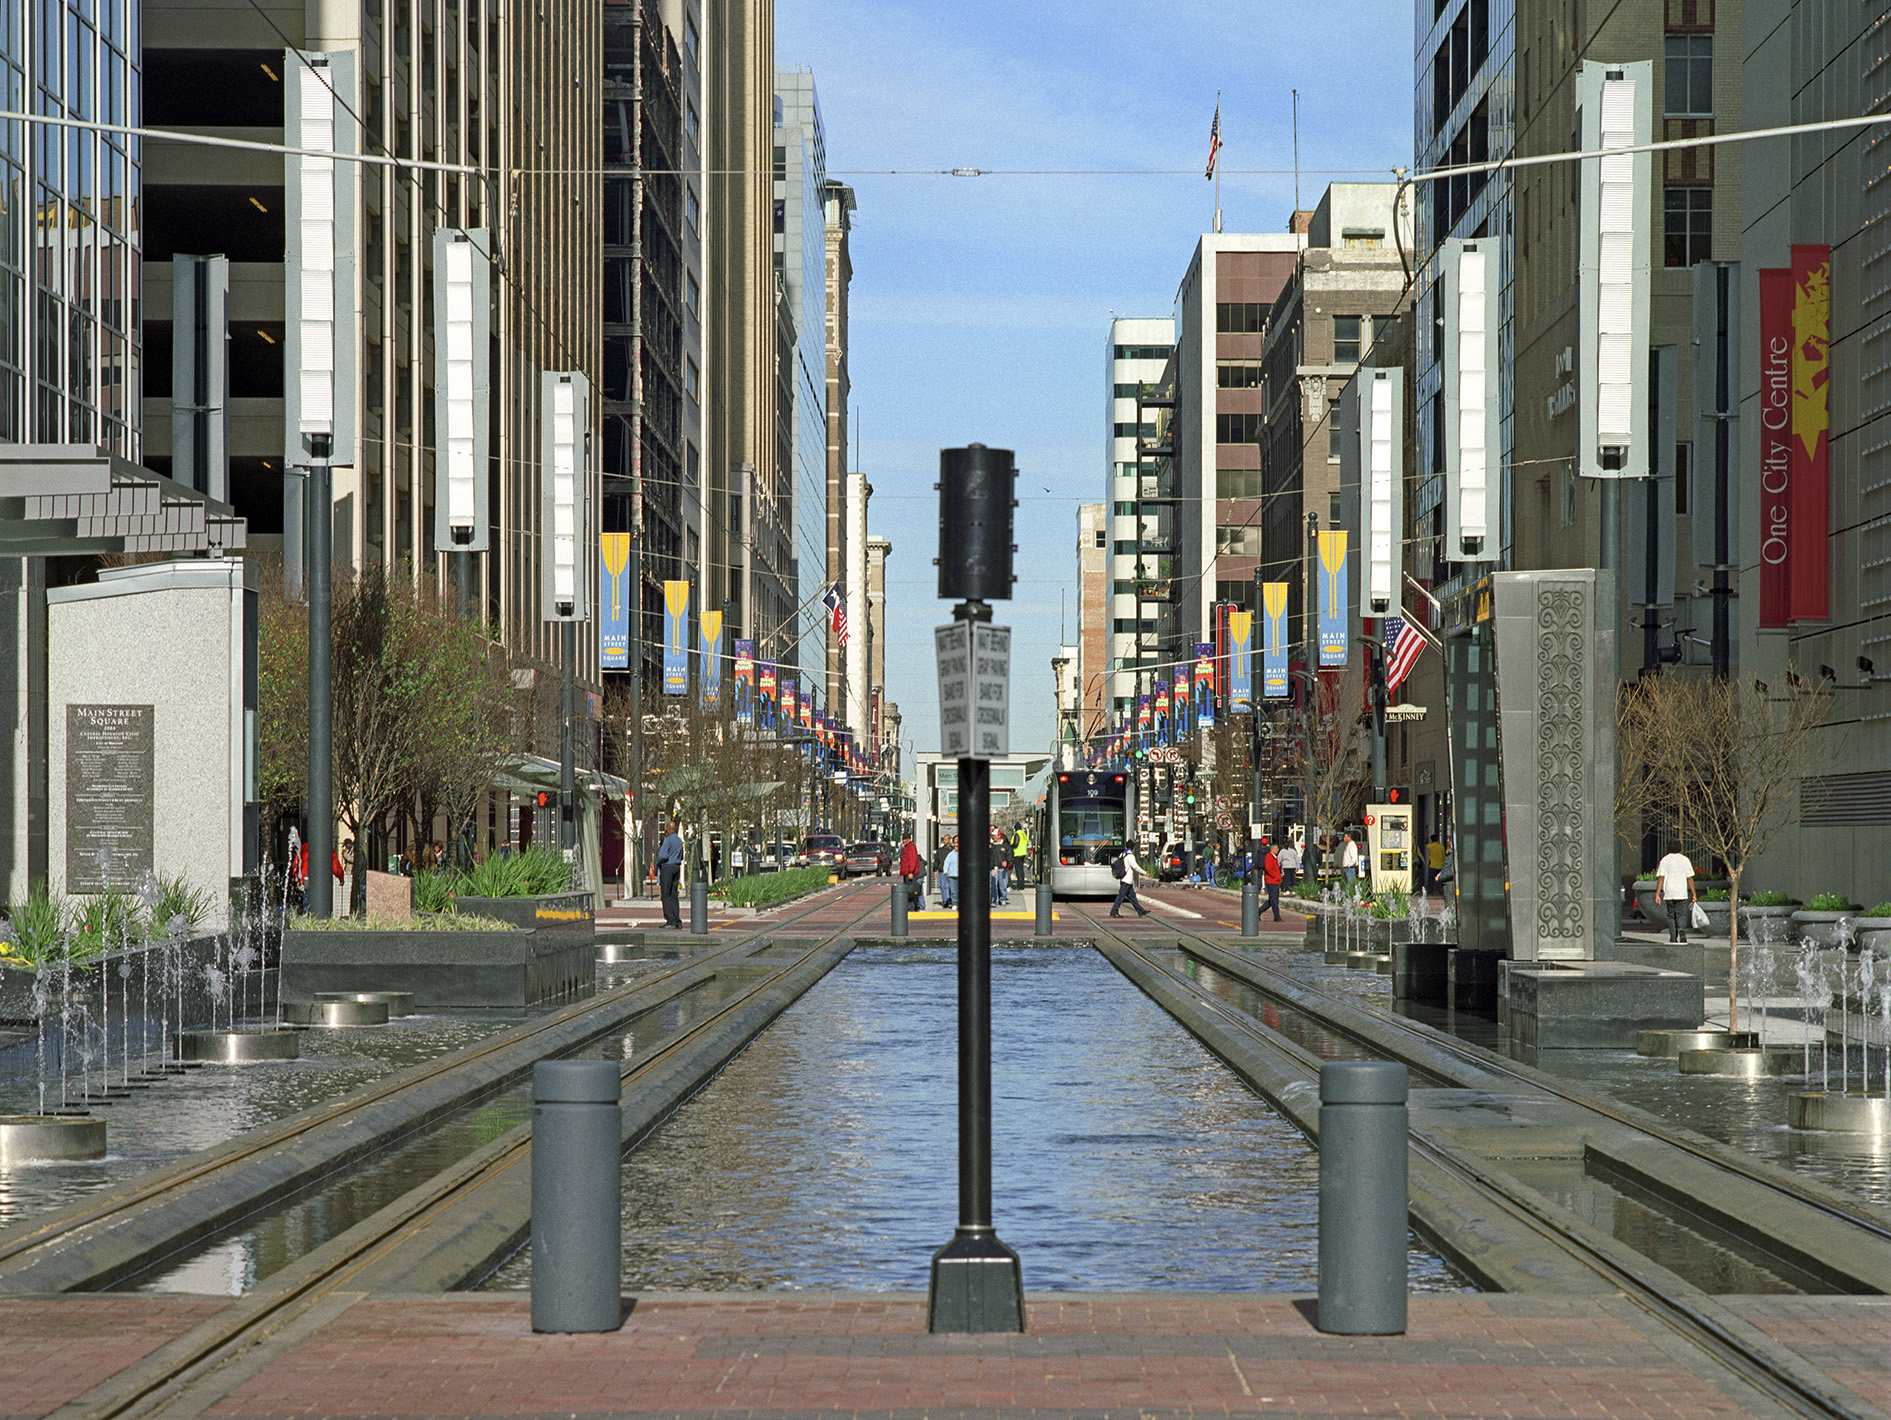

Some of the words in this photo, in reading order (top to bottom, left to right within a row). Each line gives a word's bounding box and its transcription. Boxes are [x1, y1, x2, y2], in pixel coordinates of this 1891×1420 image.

[1762, 336, 1788, 430] Centre
[1762, 440, 1793, 494] City
[1761, 505, 1788, 565] One
[77, 708, 105, 717] MAIN
[106, 708, 142, 717] STREET
[90, 716, 129, 726] SQUARE
